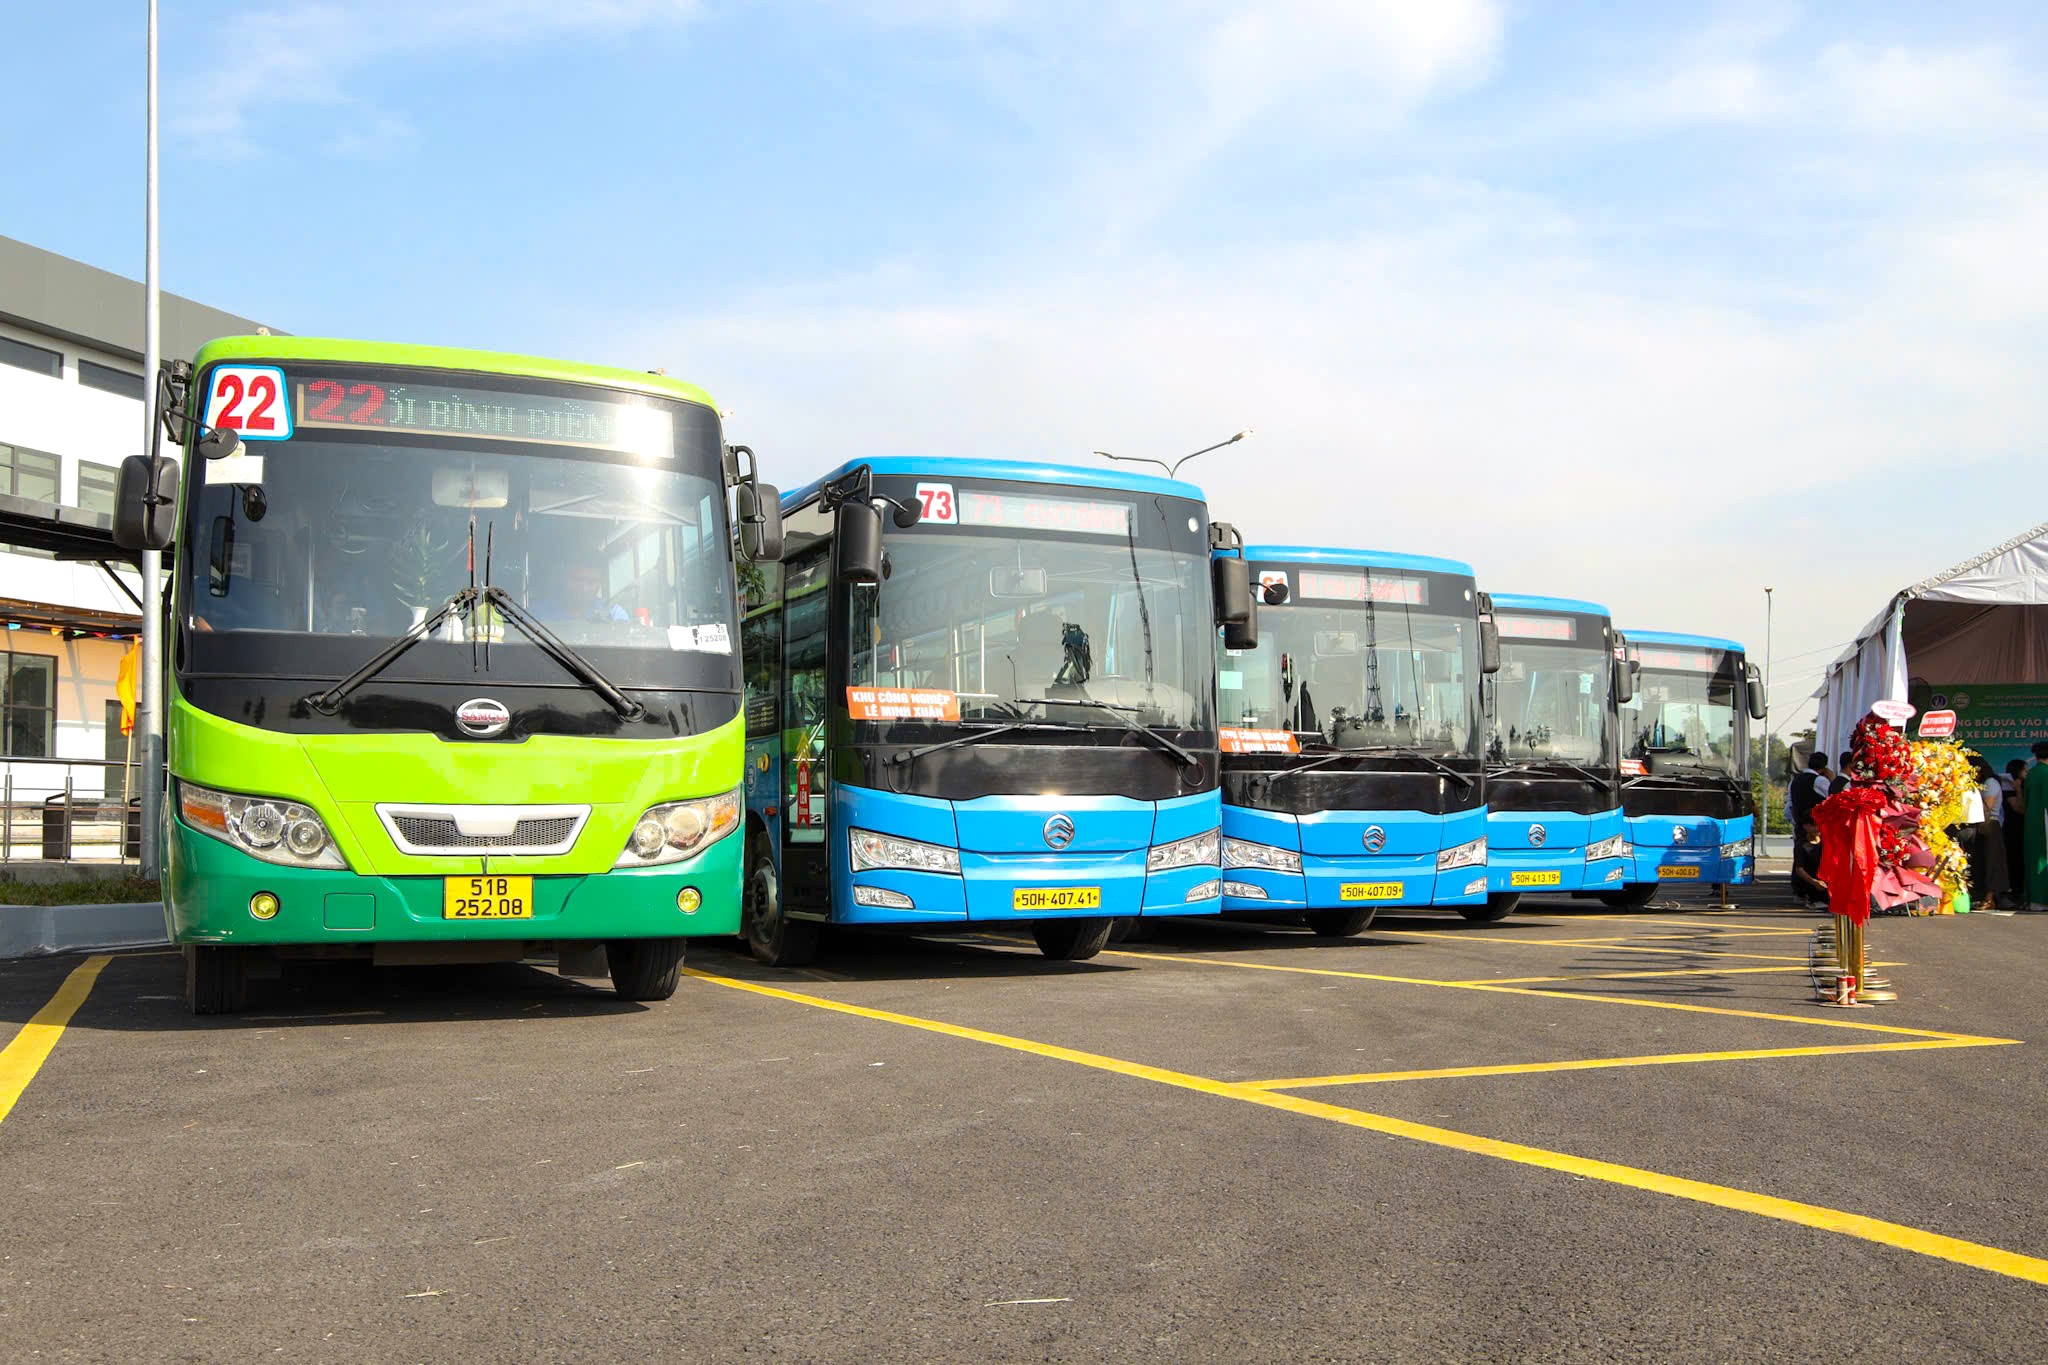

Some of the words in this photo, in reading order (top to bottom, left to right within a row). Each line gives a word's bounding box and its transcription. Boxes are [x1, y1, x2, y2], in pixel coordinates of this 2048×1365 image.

[215, 374, 276, 430] 22
[308, 379, 385, 424] 22
[428, 394, 515, 433] BÌNH
[919, 489, 952, 520] 73
[852, 691, 875, 702] KHU
[878, 690, 909, 704] CÔNG
[911, 692, 951, 706] NGHIỆP
[864, 704, 878, 717] LÊ
[881, 705, 911, 717] MINH
[913, 704, 944, 718] XUÂN
[471, 878, 508, 896] 51B
[455, 898, 523, 916] 252.08
[1021, 892, 1092, 906] 50H-407.41
